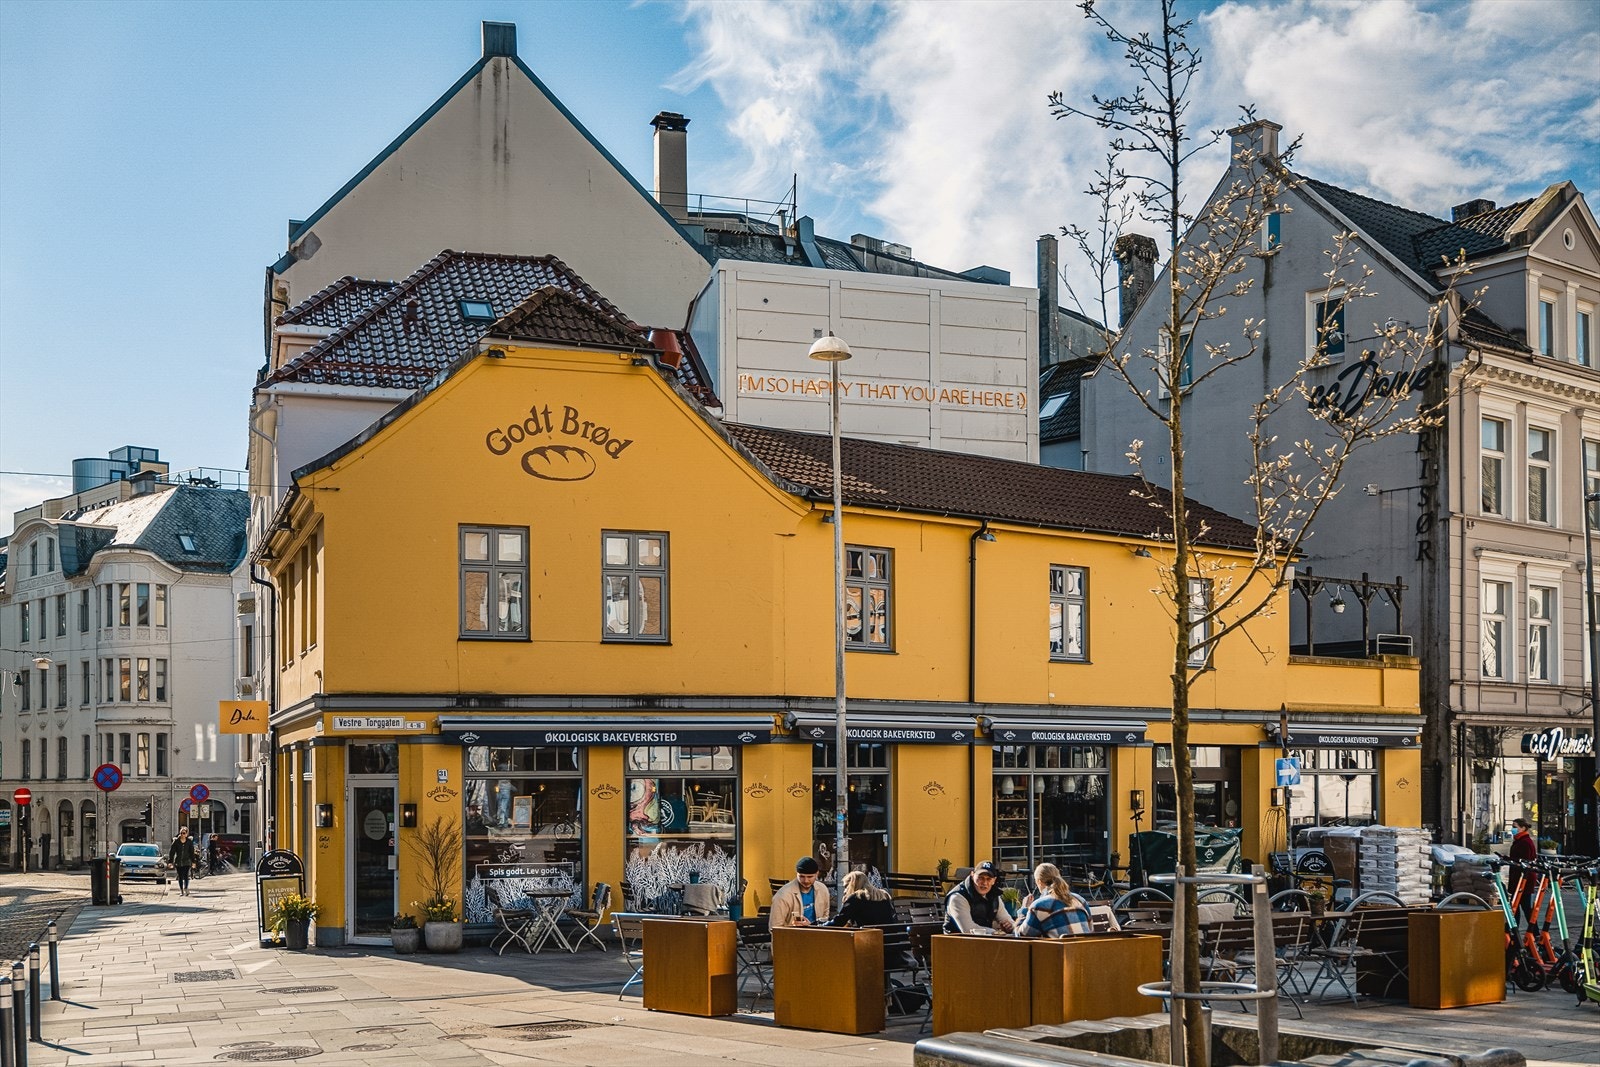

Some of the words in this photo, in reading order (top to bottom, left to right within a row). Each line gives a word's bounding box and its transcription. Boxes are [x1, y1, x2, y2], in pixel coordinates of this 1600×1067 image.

[739, 375, 764, 391] I'M
[767, 377, 789, 393] SO
[855, 382, 900, 399] THAT
[902, 385, 936, 402] YOU
[939, 389, 969, 405] ARE
[972, 391, 1014, 408] HERE
[486, 404, 553, 456] Godt
[560, 405, 634, 460] Brød
[338, 718, 362, 727] Vestre
[366, 718, 400, 728] Torggaten
[544, 732, 600, 743] ØKOLOGISK
[602, 732, 677, 742] BAKEVERKSTED
[846, 729, 882, 738] KOLOGISK
[883, 730, 936, 739] BAKEVERKSTED
[1031, 731, 1066, 741] ØKOLOGISK
[1066, 732, 1111, 741] BAKEVERKSTED
[1344, 736, 1378, 744] BAKEVERKSTED
[426, 785, 441, 798] Godt
[590, 784, 605, 795] Godt
[489, 868, 505, 877] Spis
[505, 867, 526, 877] godt.
[526, 867, 539, 875] Lev
[540, 866, 560, 875] godt.
